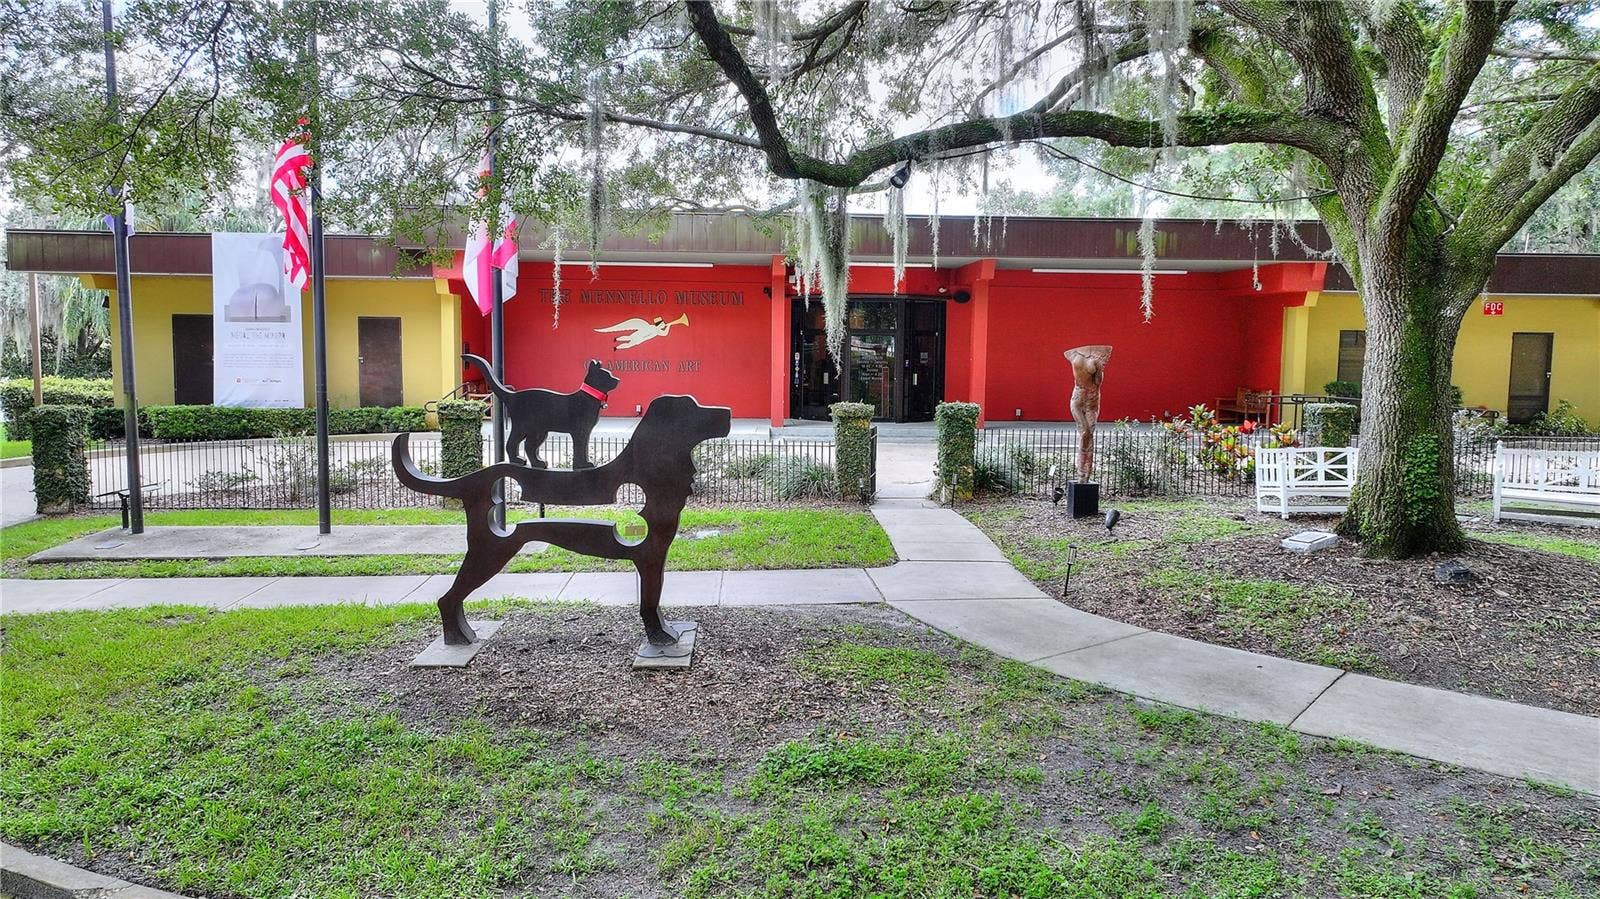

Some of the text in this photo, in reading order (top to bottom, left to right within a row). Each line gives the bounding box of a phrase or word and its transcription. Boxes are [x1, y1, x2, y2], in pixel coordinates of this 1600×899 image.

[580, 289, 668, 305] MENNELLO
[675, 290, 745, 306] MUSEUM
[1485, 302, 1502, 311] FDC
[607, 360, 670, 372] AMERICAN
[678, 360, 703, 372] ART
